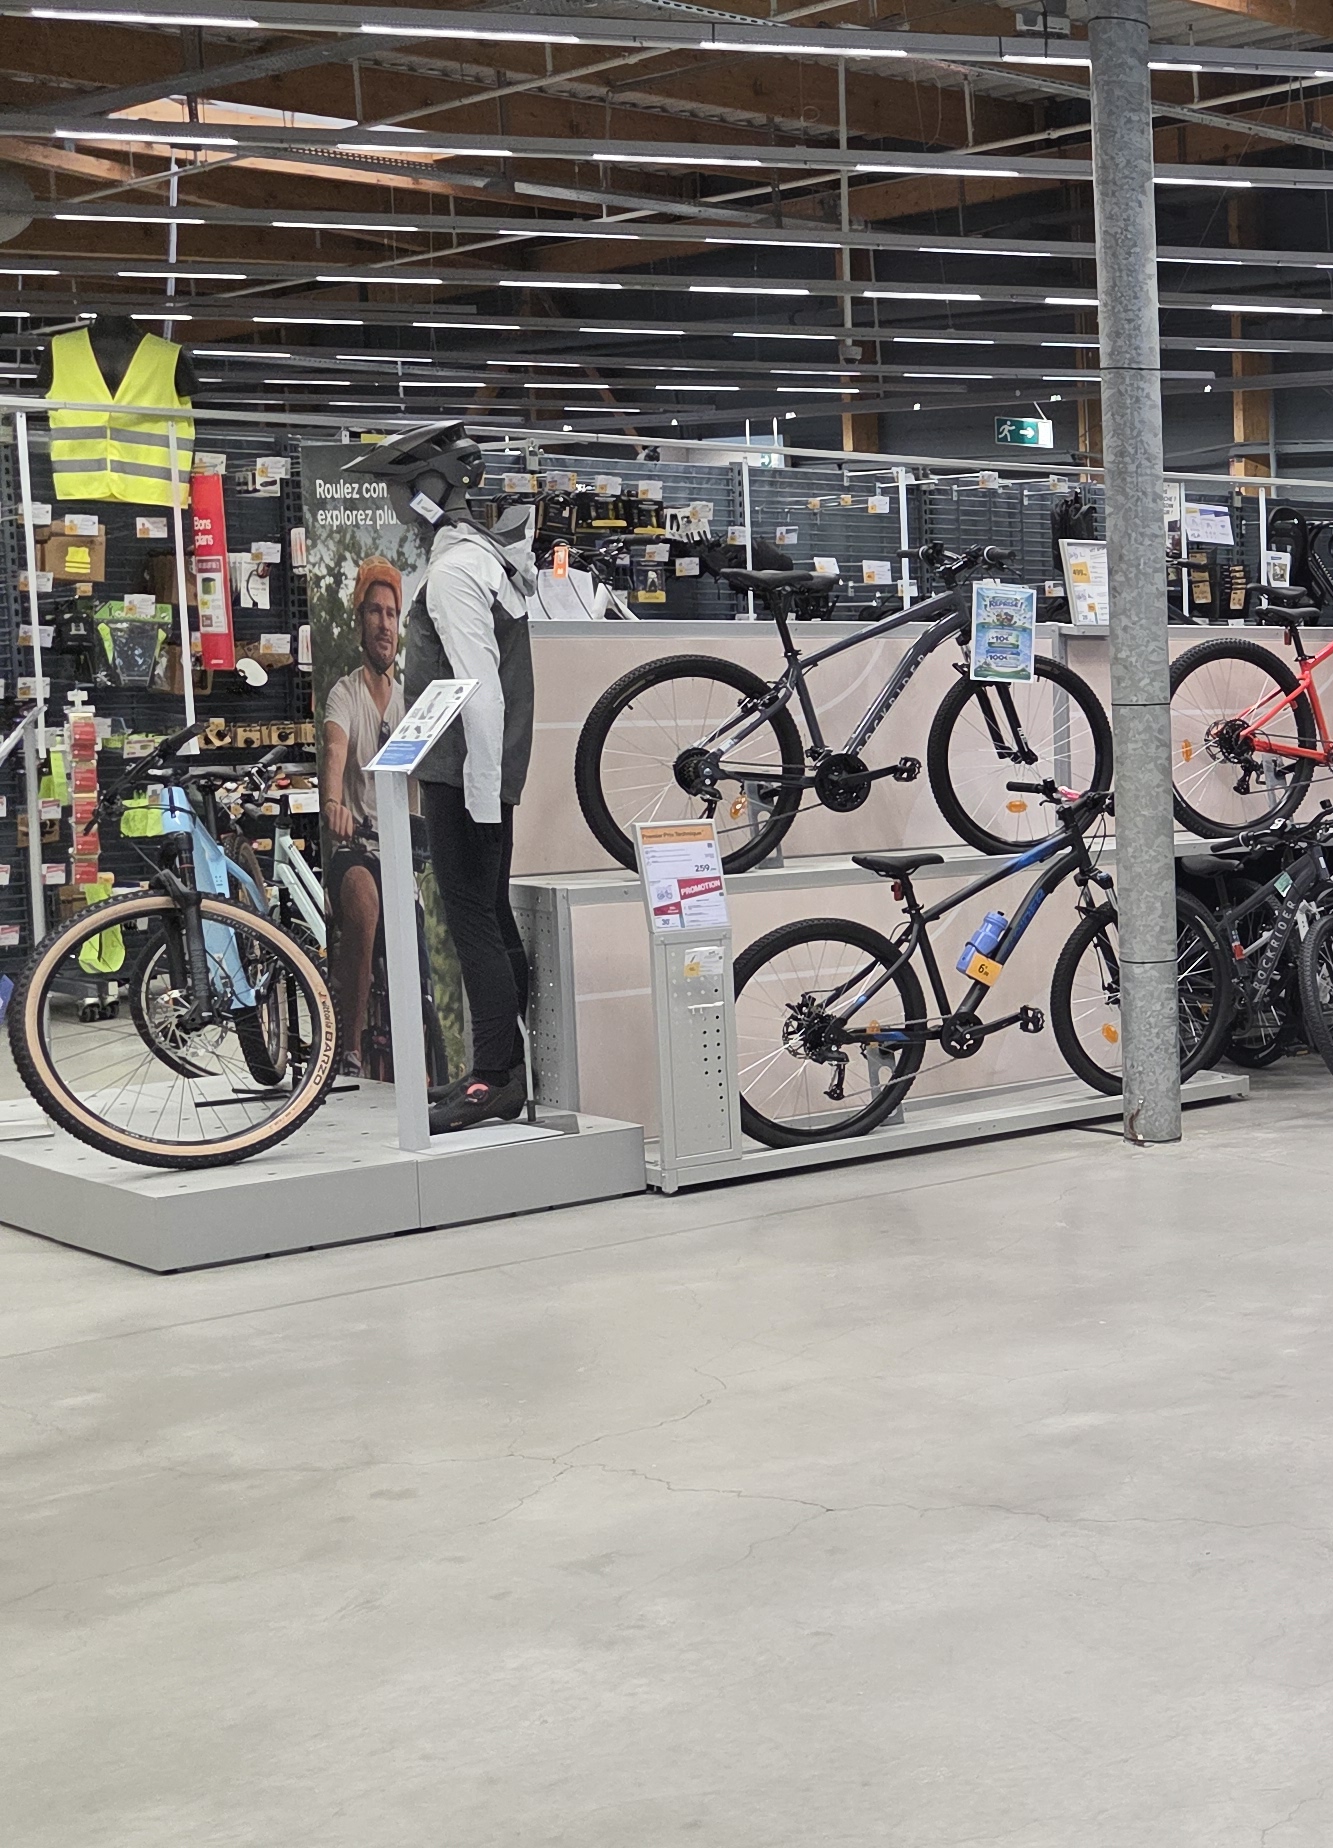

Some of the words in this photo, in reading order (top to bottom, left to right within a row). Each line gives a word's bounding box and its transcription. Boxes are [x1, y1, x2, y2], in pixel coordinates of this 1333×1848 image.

[315, 479, 360, 499] Roulez
[362, 482, 388, 498] con
[193, 516, 212, 531] Bons
[317, 505, 374, 531] explorez
[375, 504, 400, 530] plu
[194, 532, 214, 549] plans
[680, 878, 721, 897] PROMOTION
[1252, 899, 1297, 991] ROCKRIDER
[313, 1030, 334, 1086] BARZO
